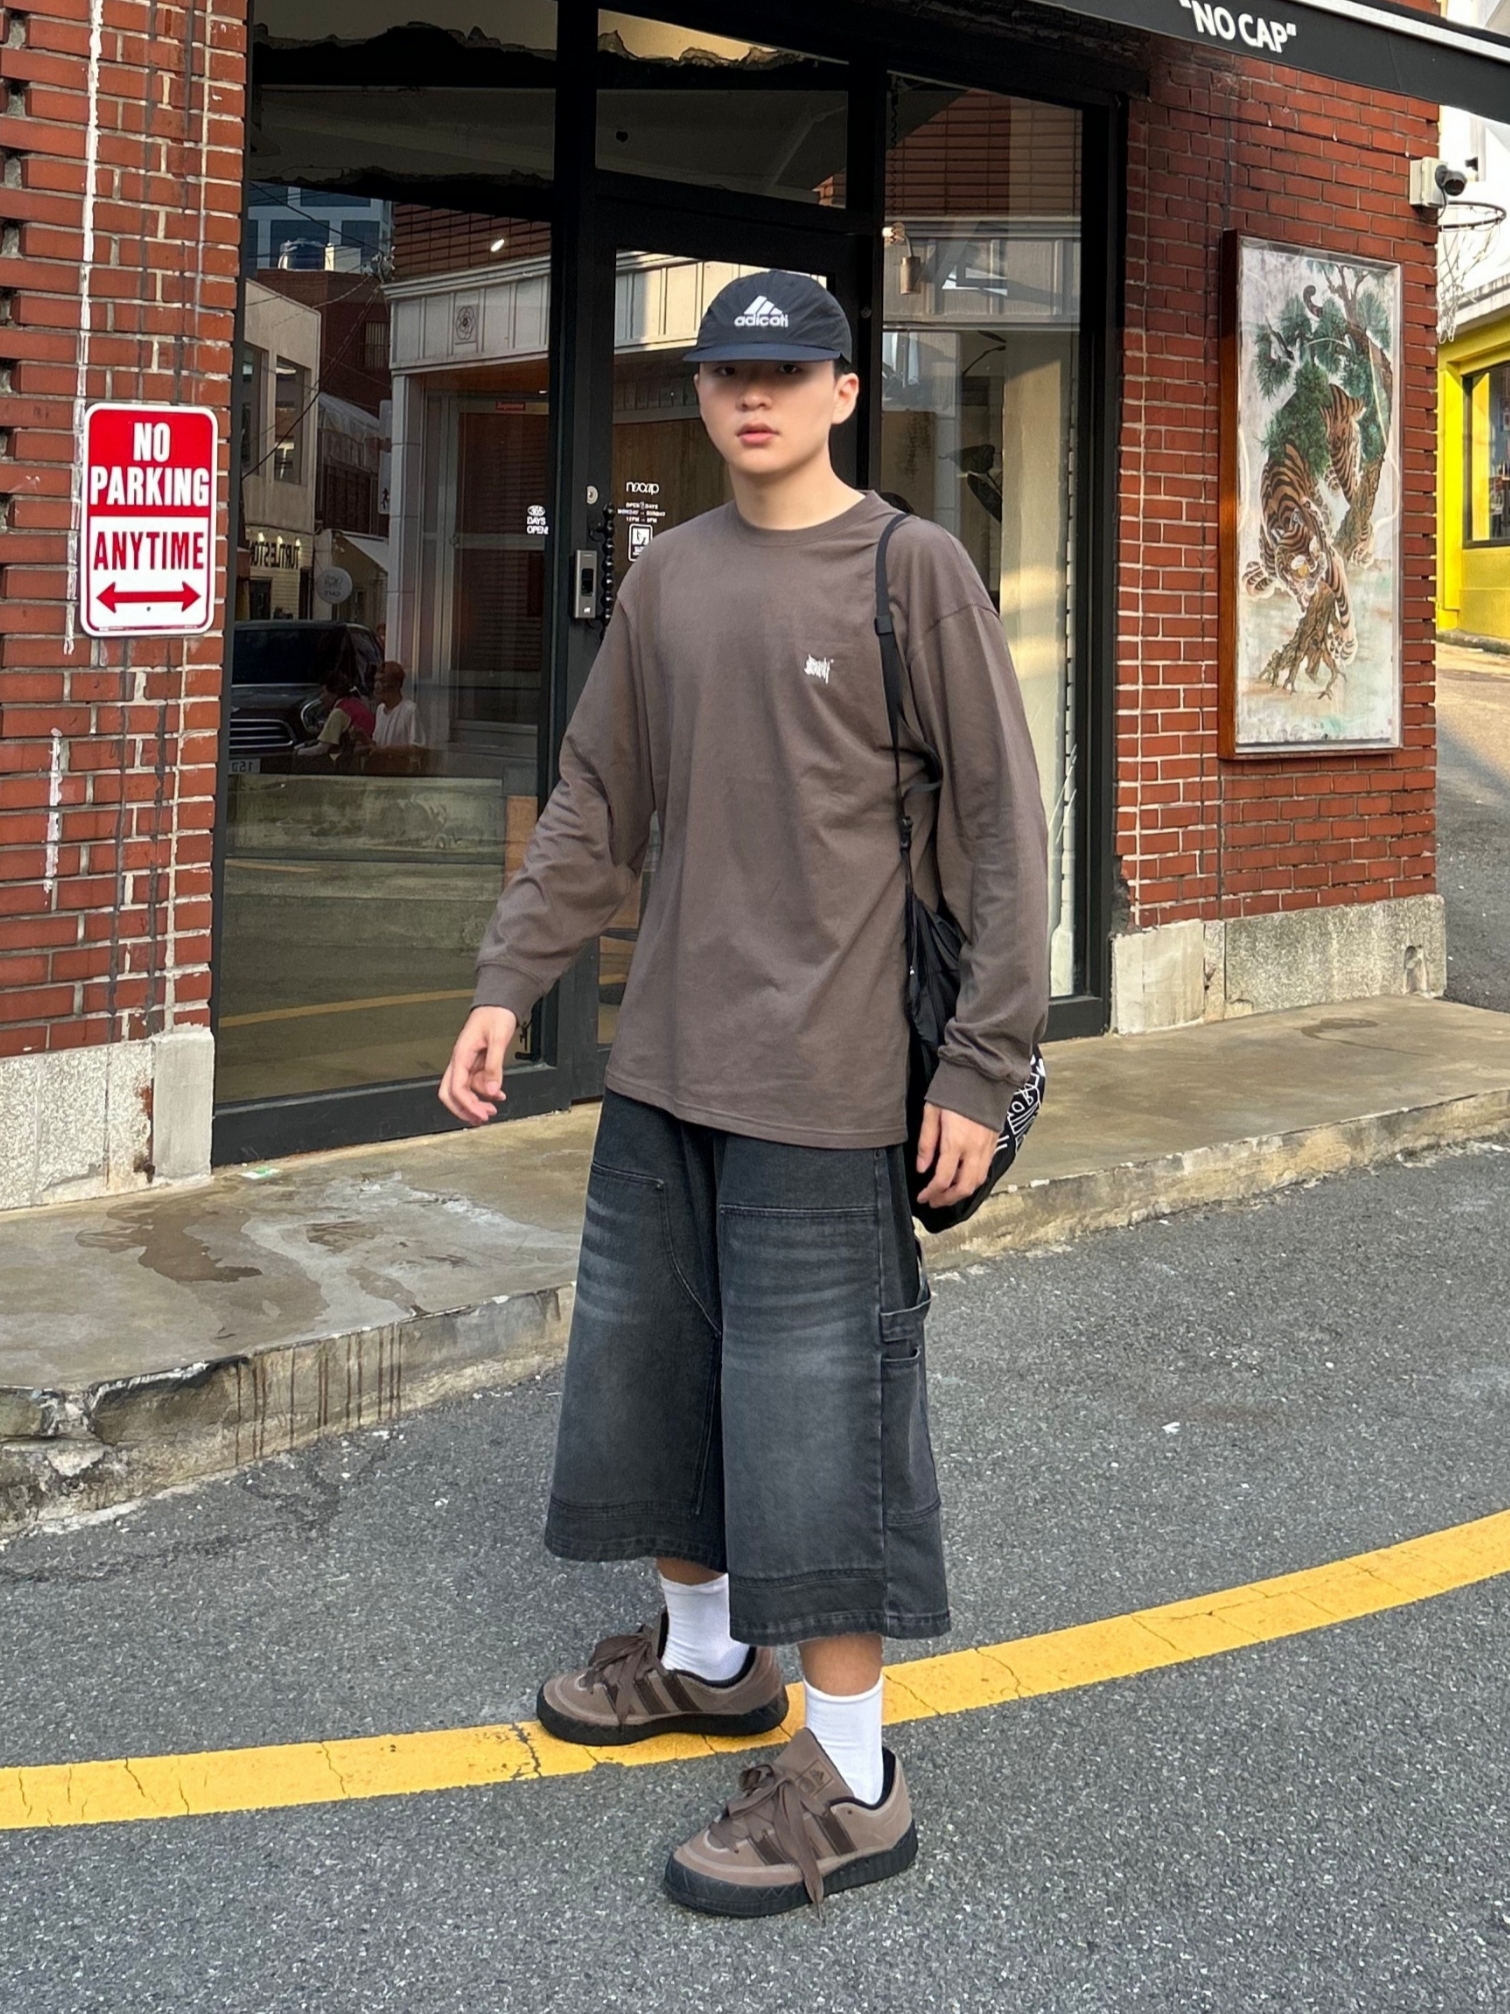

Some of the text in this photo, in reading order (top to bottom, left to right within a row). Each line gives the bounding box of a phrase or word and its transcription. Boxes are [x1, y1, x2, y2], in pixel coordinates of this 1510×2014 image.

[1238, 13, 1297, 53] CAP"
[133, 422, 171, 462] NO
[90, 465, 210, 507] PARKING
[527, 516, 546, 525] DAYS
[93, 530, 205, 571] ANYTIME
